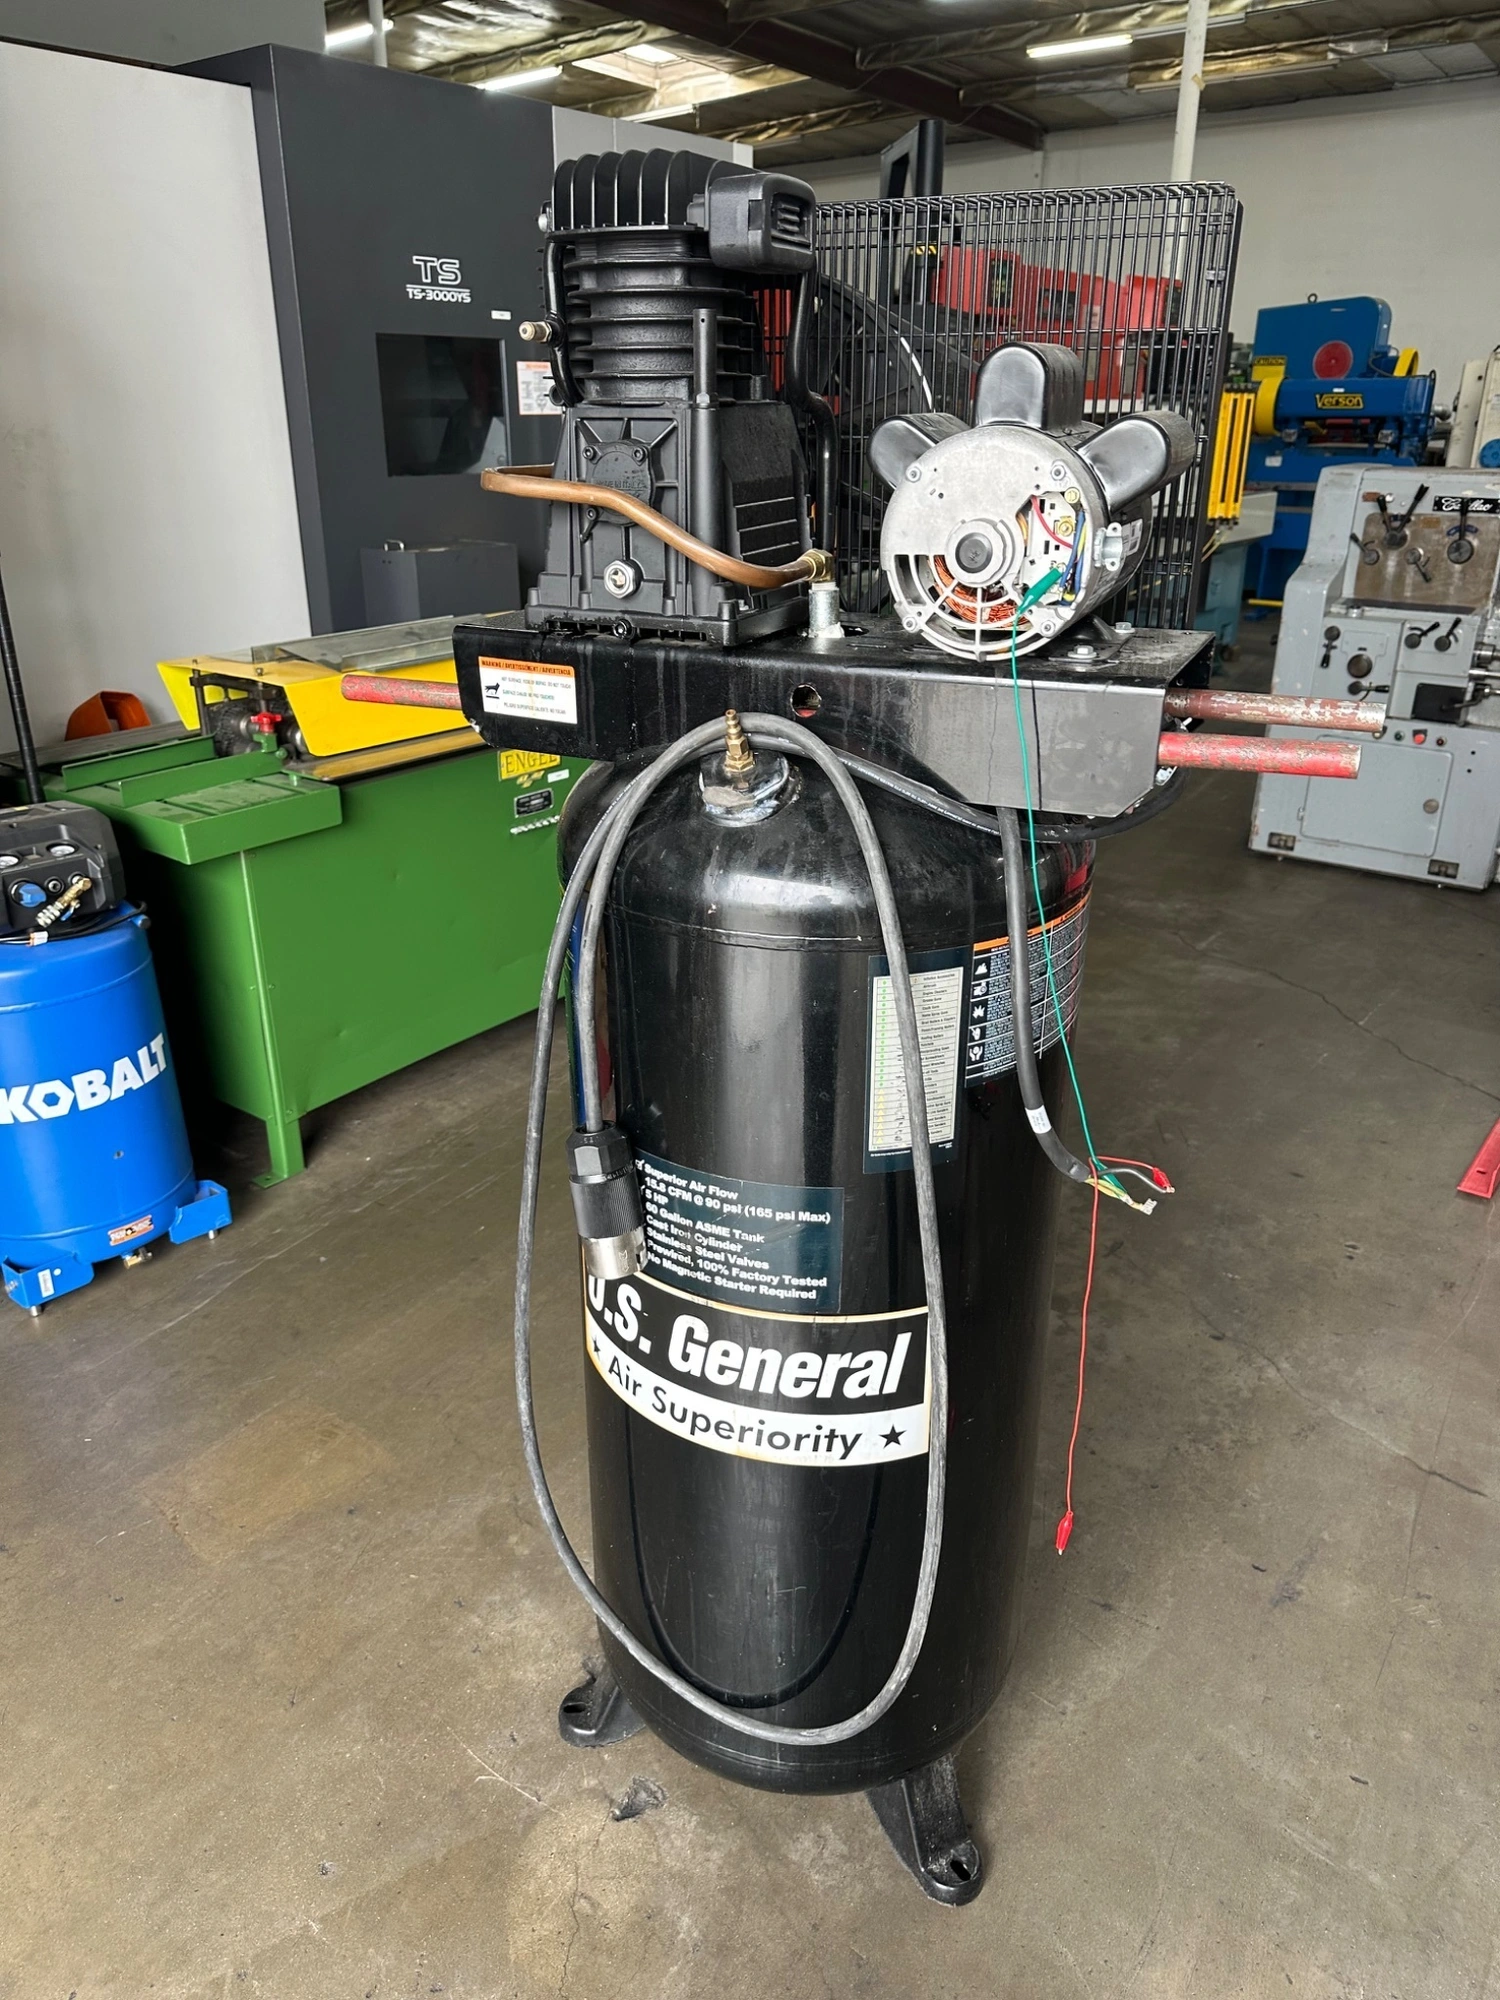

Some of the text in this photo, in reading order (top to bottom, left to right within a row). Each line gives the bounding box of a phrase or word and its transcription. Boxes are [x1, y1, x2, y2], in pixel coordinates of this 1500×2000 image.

[412, 255, 461, 285] TS
[406, 288, 471, 303] TS-3000YS
[1315, 393, 1363, 409] Verson
[1442, 497, 1493, 511] Callac
[0, 1033, 167, 1124] KOBALT
[644, 1163, 687, 1187] Superior
[689, 1180, 707, 1194] Air
[709, 1184, 738, 1200] Flow
[645, 1189, 669, 1206] 5 HP
[645, 1177, 831, 1224] 15.8 CFM @ 90 psi (165 psi Max)
[646, 1202, 765, 1244] 60 Gallon ASME Tank
[646, 1215, 743, 1253] Cast Iron Cylinder
[647, 1227, 770, 1270] Stainless Steel Valves
[647, 1240, 828, 1288] Prewired, 100% Factory Tested
[647, 1252, 817, 1300] No Magnetic Starter Required
[588, 1275, 913, 1400] U.S. General
[608, 1354, 863, 1460] Air Superiority
